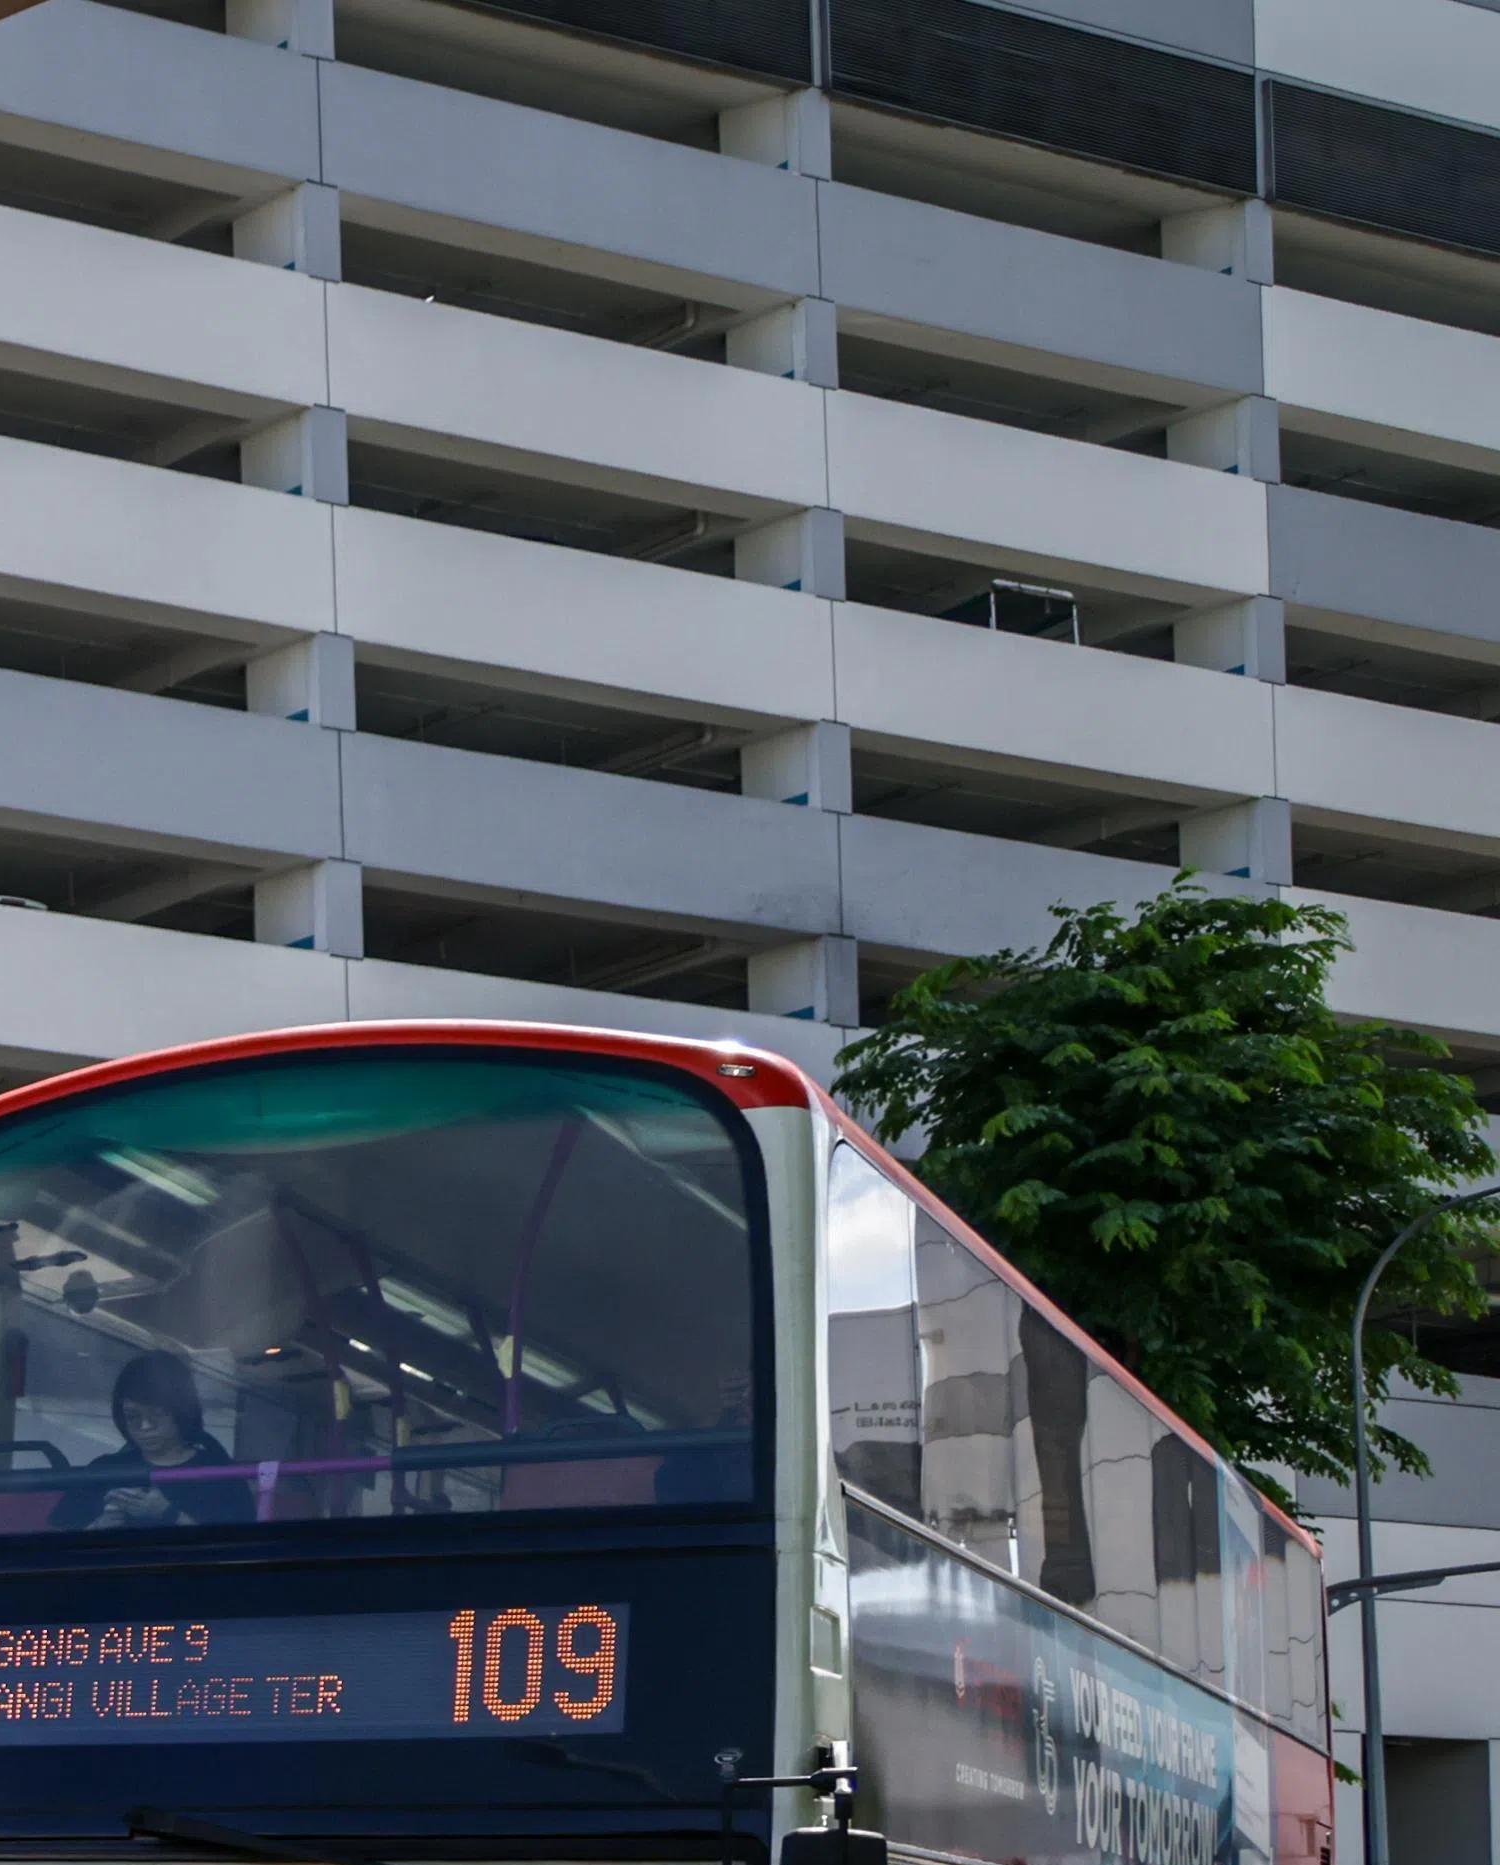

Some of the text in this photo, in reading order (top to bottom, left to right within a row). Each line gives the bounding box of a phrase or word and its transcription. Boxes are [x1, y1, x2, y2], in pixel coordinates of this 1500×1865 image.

[99, 1624, 175, 1665] AVE
[184, 1624, 210, 1662] 9
[448, 1605, 617, 1723] 109
[90, 1676, 253, 1718] VILLAGE
[269, 1674, 344, 1714] TER
[1069, 1666, 1111, 1747] YOUR
[1072, 1755, 1123, 1856] YOUR
